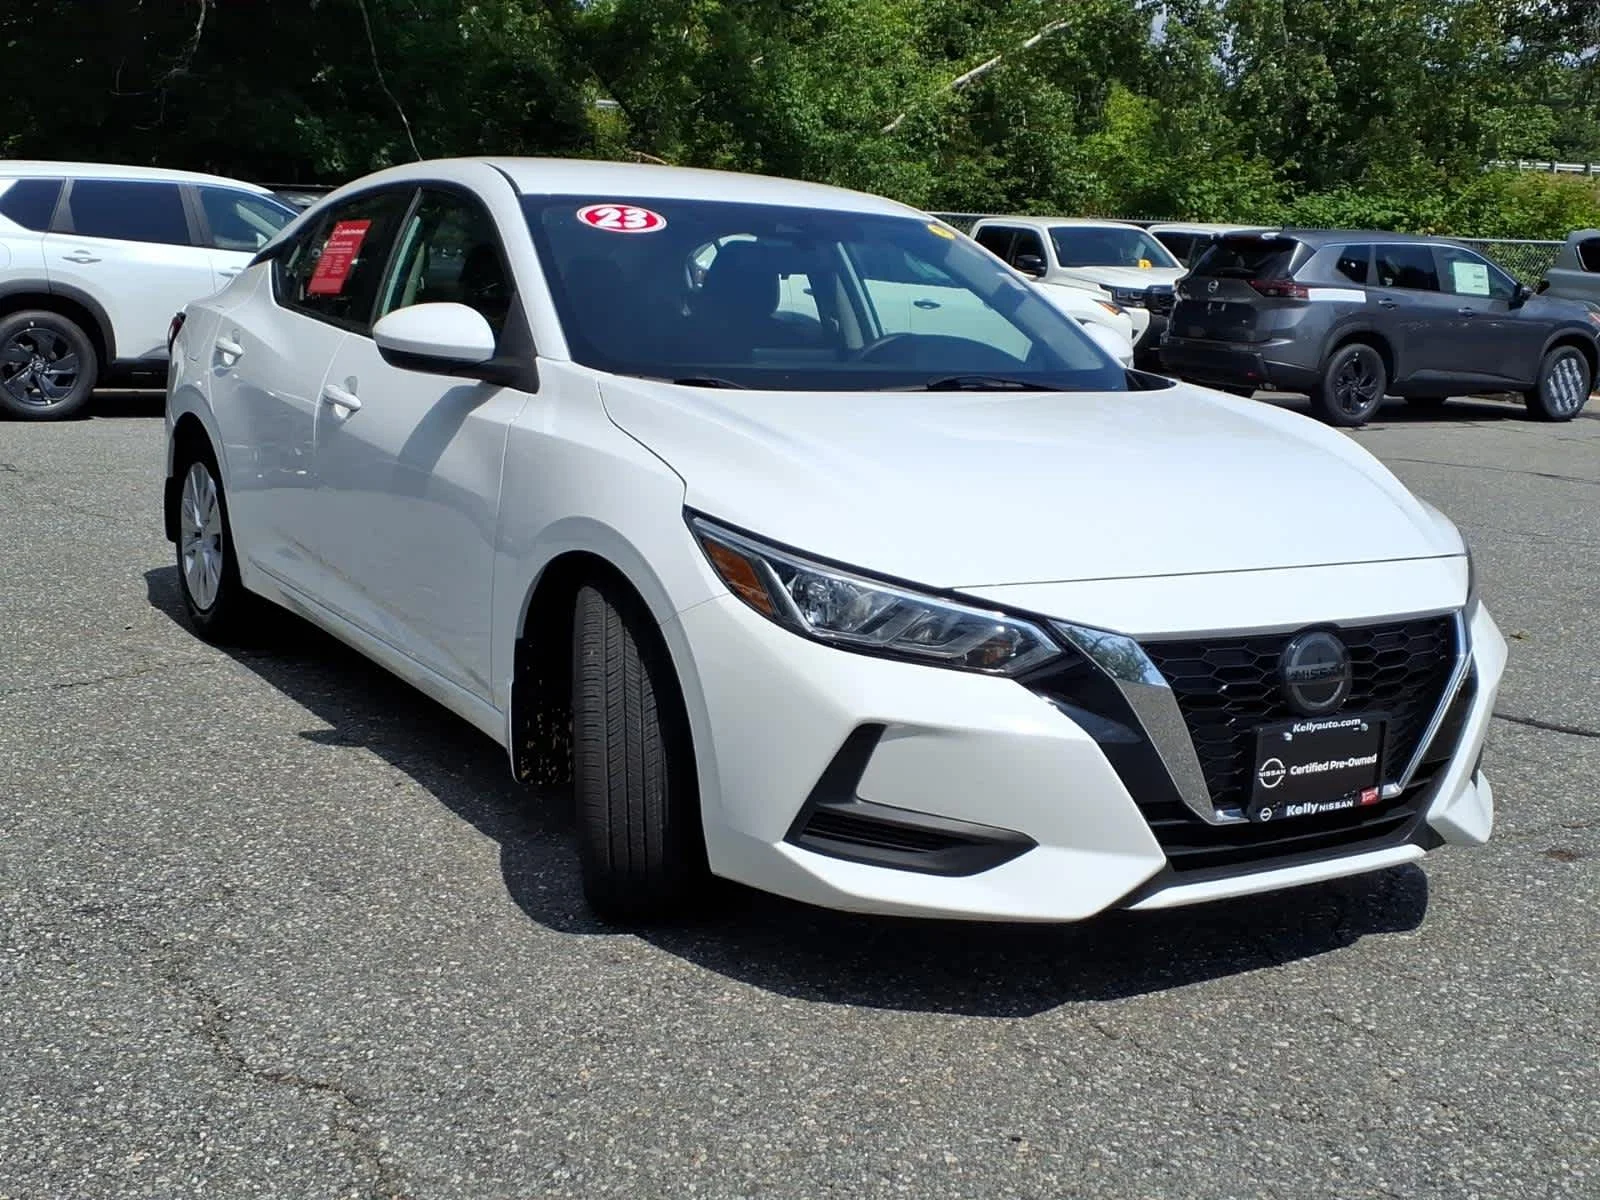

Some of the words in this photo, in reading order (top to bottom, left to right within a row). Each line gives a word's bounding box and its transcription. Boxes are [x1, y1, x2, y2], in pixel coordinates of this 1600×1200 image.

[593, 207, 648, 229] 23
[1292, 718, 1361, 732] Kellyauto.com
[1290, 760, 1328, 775] Certified
[1330, 753, 1378, 769] Pre-Owned
[1259, 768, 1286, 777] NISSAN
[1286, 802, 1318, 816] Kelly
[1320, 800, 1354, 811] NISSAN
